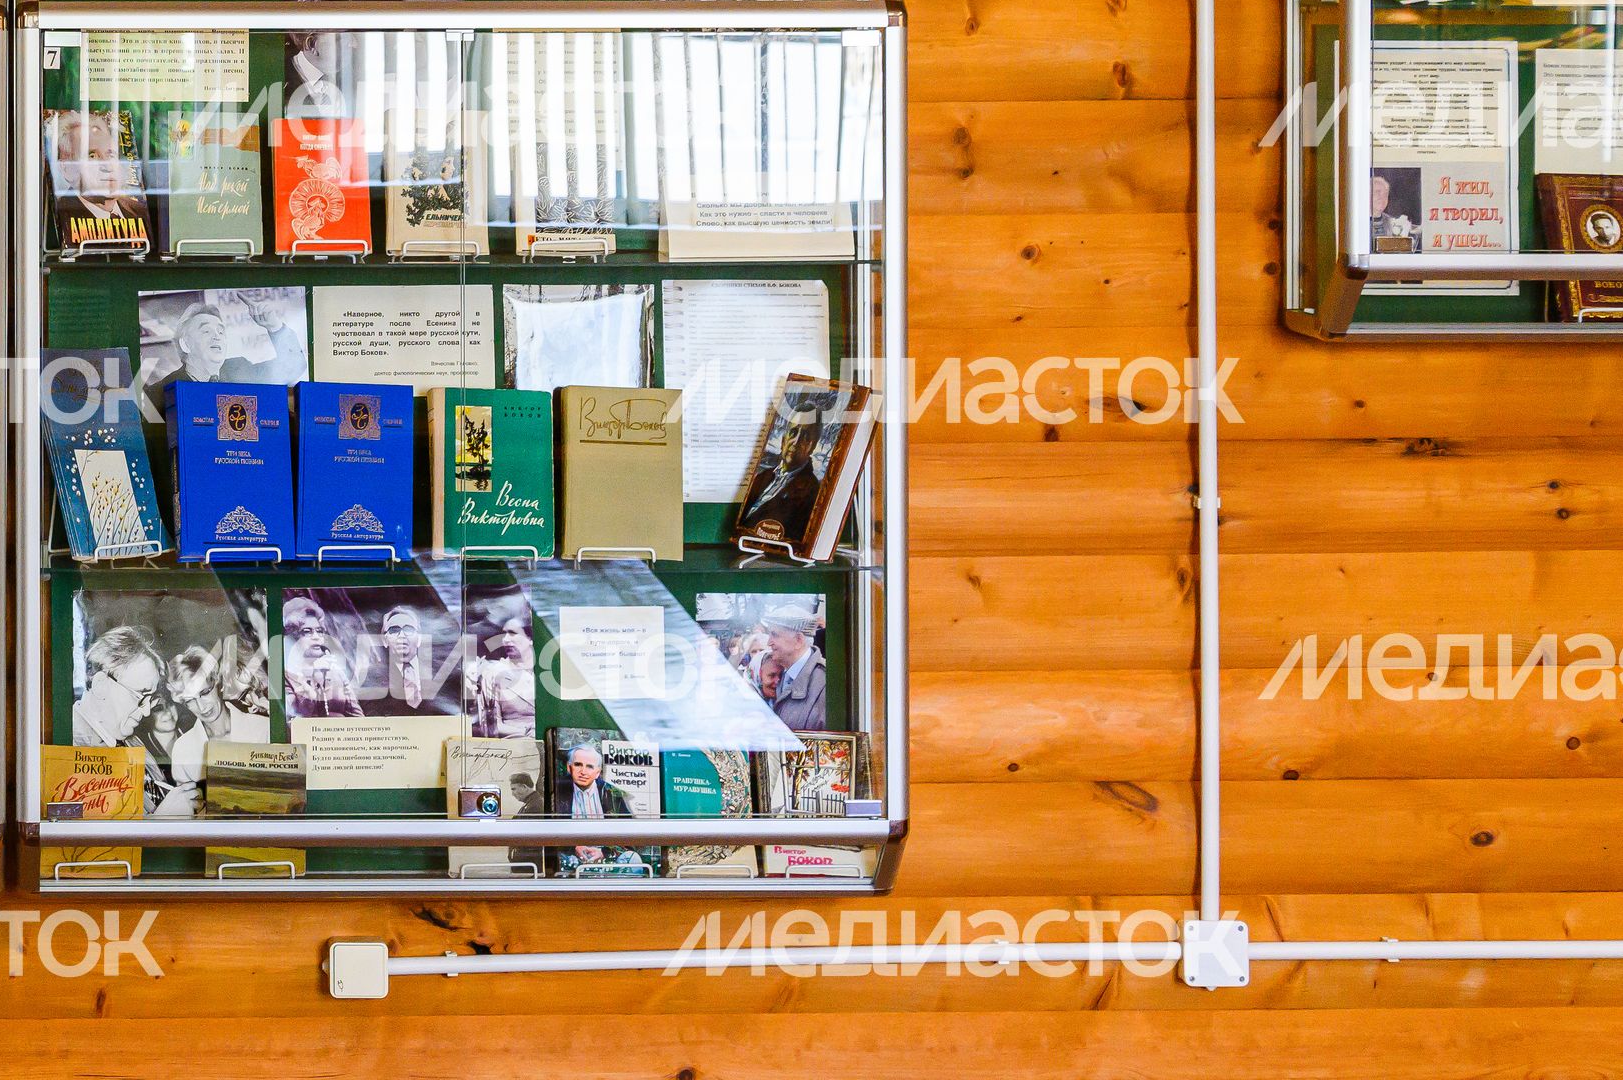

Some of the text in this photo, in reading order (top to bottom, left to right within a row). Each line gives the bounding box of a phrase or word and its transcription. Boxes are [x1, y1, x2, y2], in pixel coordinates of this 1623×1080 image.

[47, 51, 57, 66] 7
[199, 175, 217, 192] Над
[1439, 177, 1493, 198] Я жил,
[1429, 208, 1503, 225] я творил,
[71, 217, 147, 248] АМПЛИТУДА
[1433, 234, 1502, 250] я ушел...
[495, 481, 538, 511] Весна
[457, 498, 545, 534] Викторовна
[74, 751, 107, 763] Виктор
[608, 745, 649, 757] Виктор
[215, 760, 246, 768] ЛЮБОВЬ
[604, 754, 653, 766] БОКОВ
[74, 762, 112, 776] БОКОВ
[611, 768, 646, 779] Чистый
[611, 778, 646, 788] четверг
[673, 776, 710, 786] ТРАВУШКА-
[673, 785, 716, 794] МУРАВУШКА
